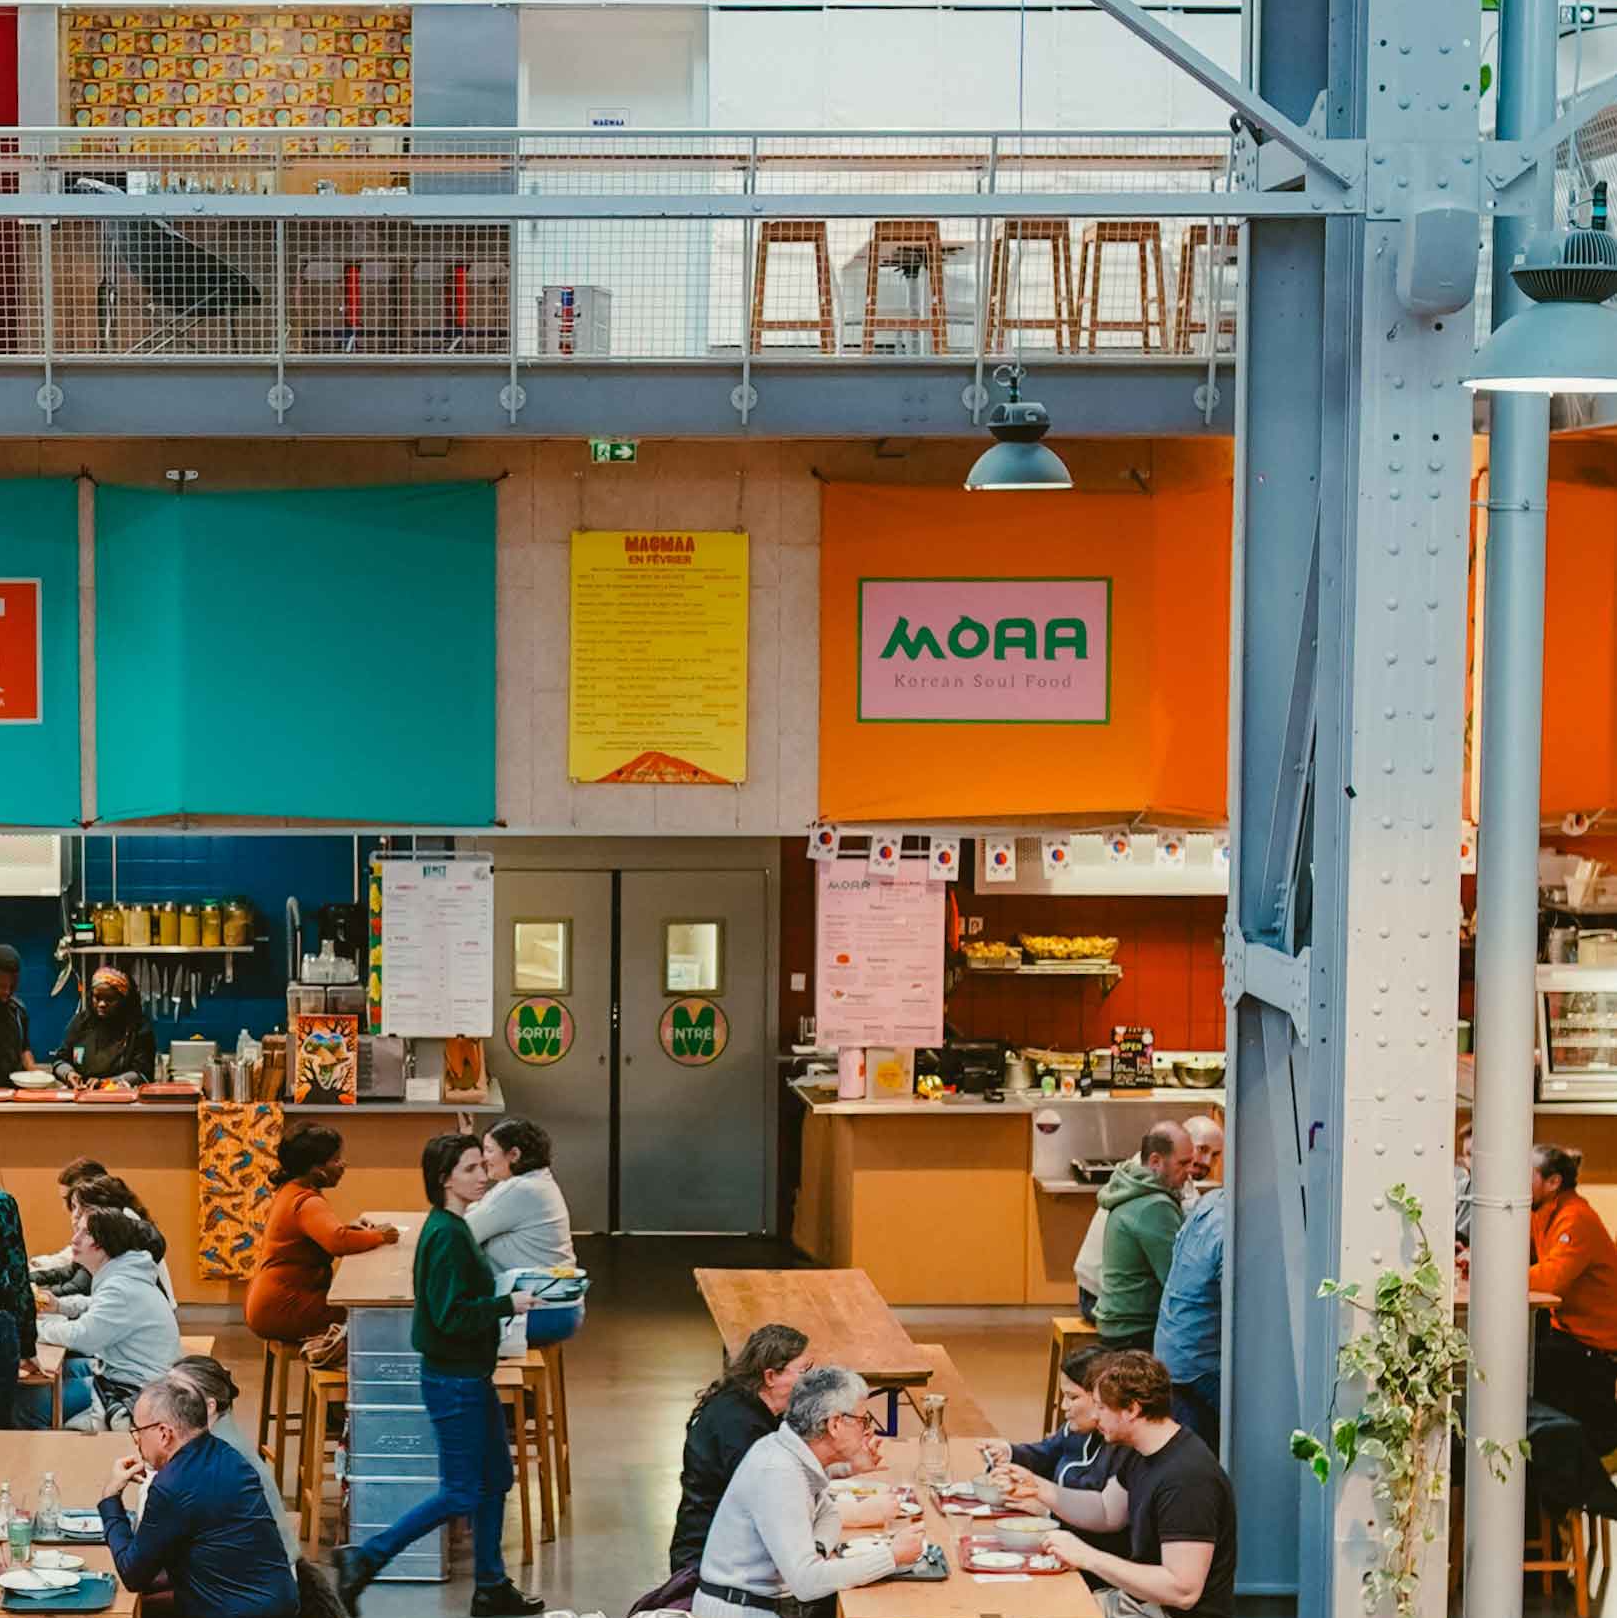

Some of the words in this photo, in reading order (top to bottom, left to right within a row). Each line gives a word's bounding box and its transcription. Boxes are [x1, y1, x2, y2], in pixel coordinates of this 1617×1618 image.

[625, 536, 695, 552] MAGMAA
[629, 555, 643, 565] EN
[648, 553, 692, 565] FÉVRIER
[878, 615, 1088, 661] MOAA
[894, 674, 964, 689] Korean
[973, 674, 1015, 689] Soul
[1025, 674, 1073, 689] Food
[513, 1026, 565, 1040] SORTIE
